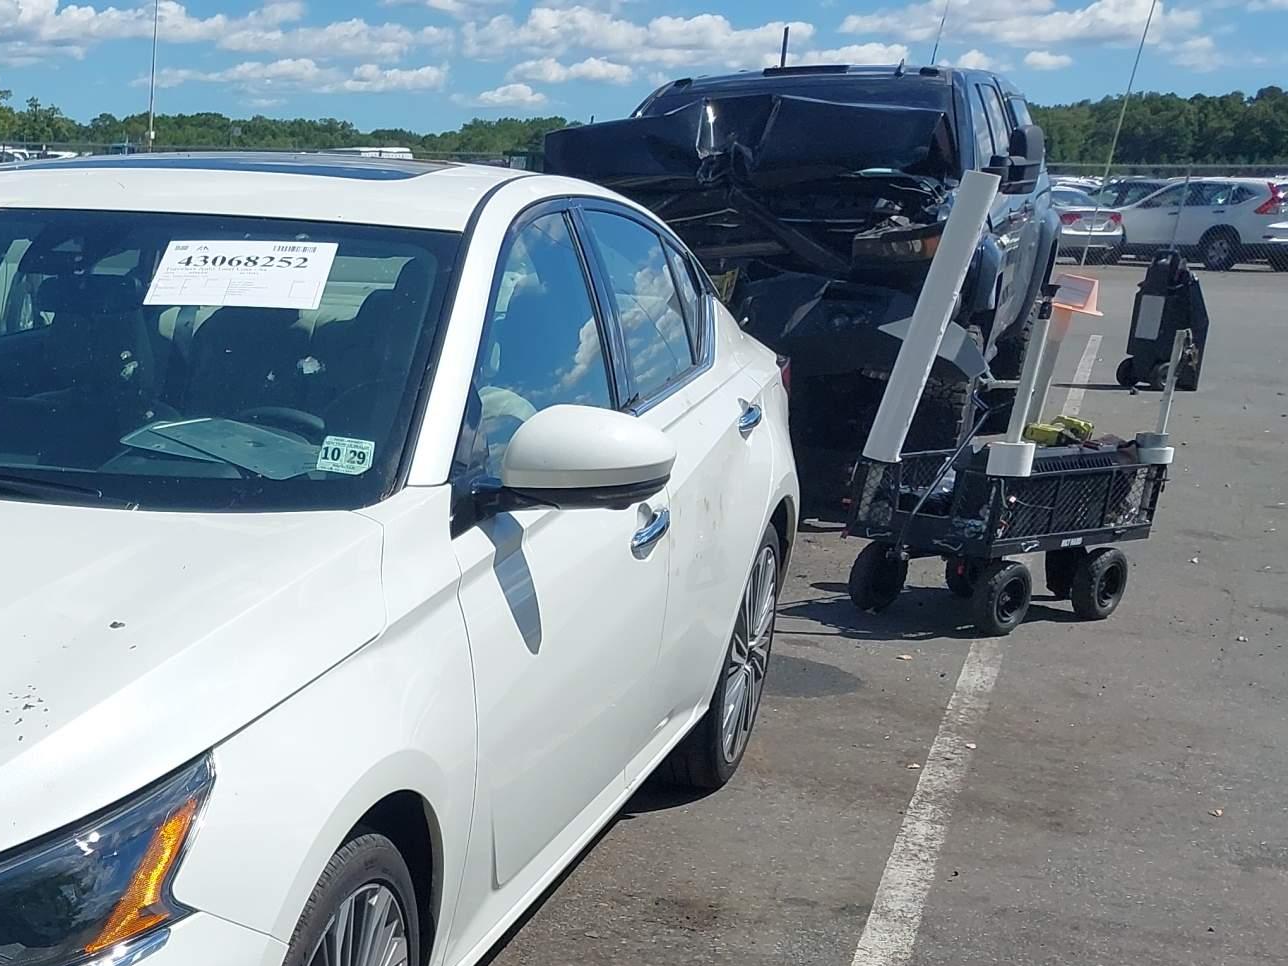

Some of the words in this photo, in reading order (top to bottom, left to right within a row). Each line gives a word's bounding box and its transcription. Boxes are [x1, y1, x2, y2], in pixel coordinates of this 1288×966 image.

[178, 255, 308, 268] 43068252
[321, 446, 341, 461] 10
[349, 450, 366, 465] 29
